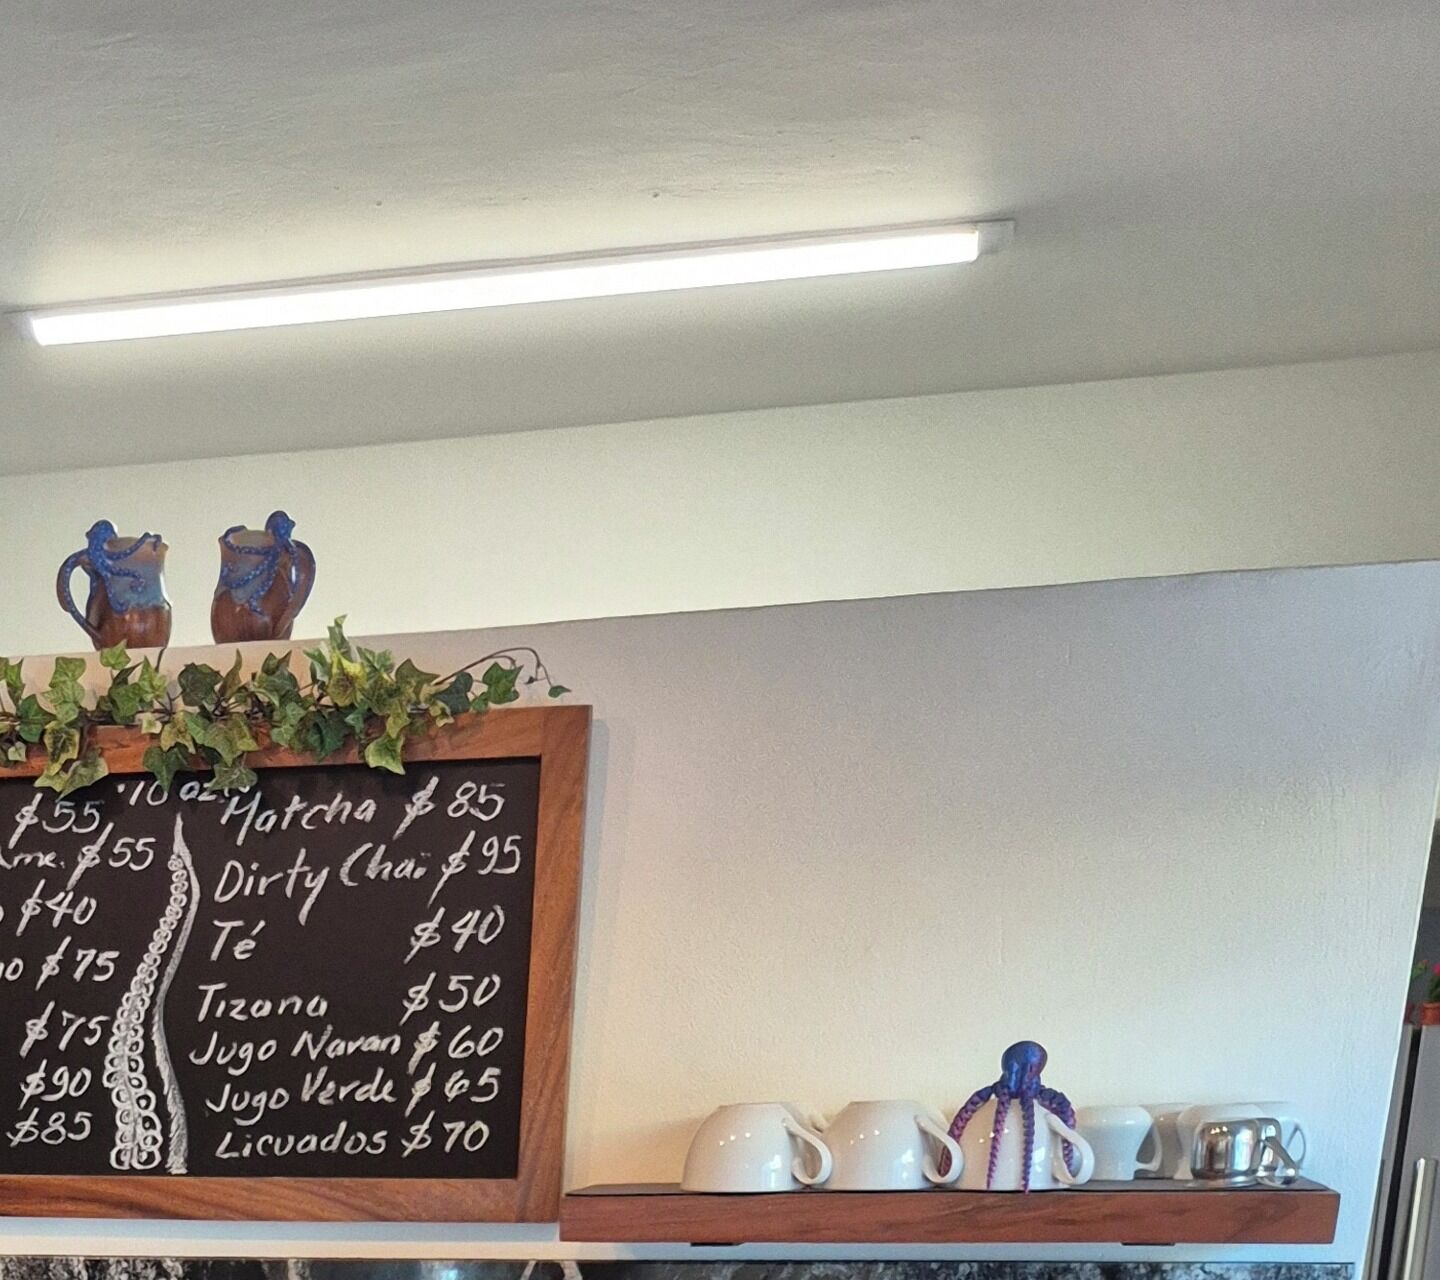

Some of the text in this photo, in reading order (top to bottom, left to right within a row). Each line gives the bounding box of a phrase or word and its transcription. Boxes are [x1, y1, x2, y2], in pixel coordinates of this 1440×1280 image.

[221, 791, 377, 845] Matcha
[16, 879, 97, 936] $40
[214, 848, 329, 926] Dirty
[212, 920, 266, 961] Té
[198, 982, 329, 1022] Tizana
[189, 1032, 278, 1077] Jugo
[291, 1024, 401, 1060] Naran
[19, 1059, 92, 1110] $90
[207, 1085, 290, 1126] Jugo
[301, 1066, 397, 1106] Verde
[6, 1107, 93, 1148] $85
[216, 1121, 387, 1159] Licuados
